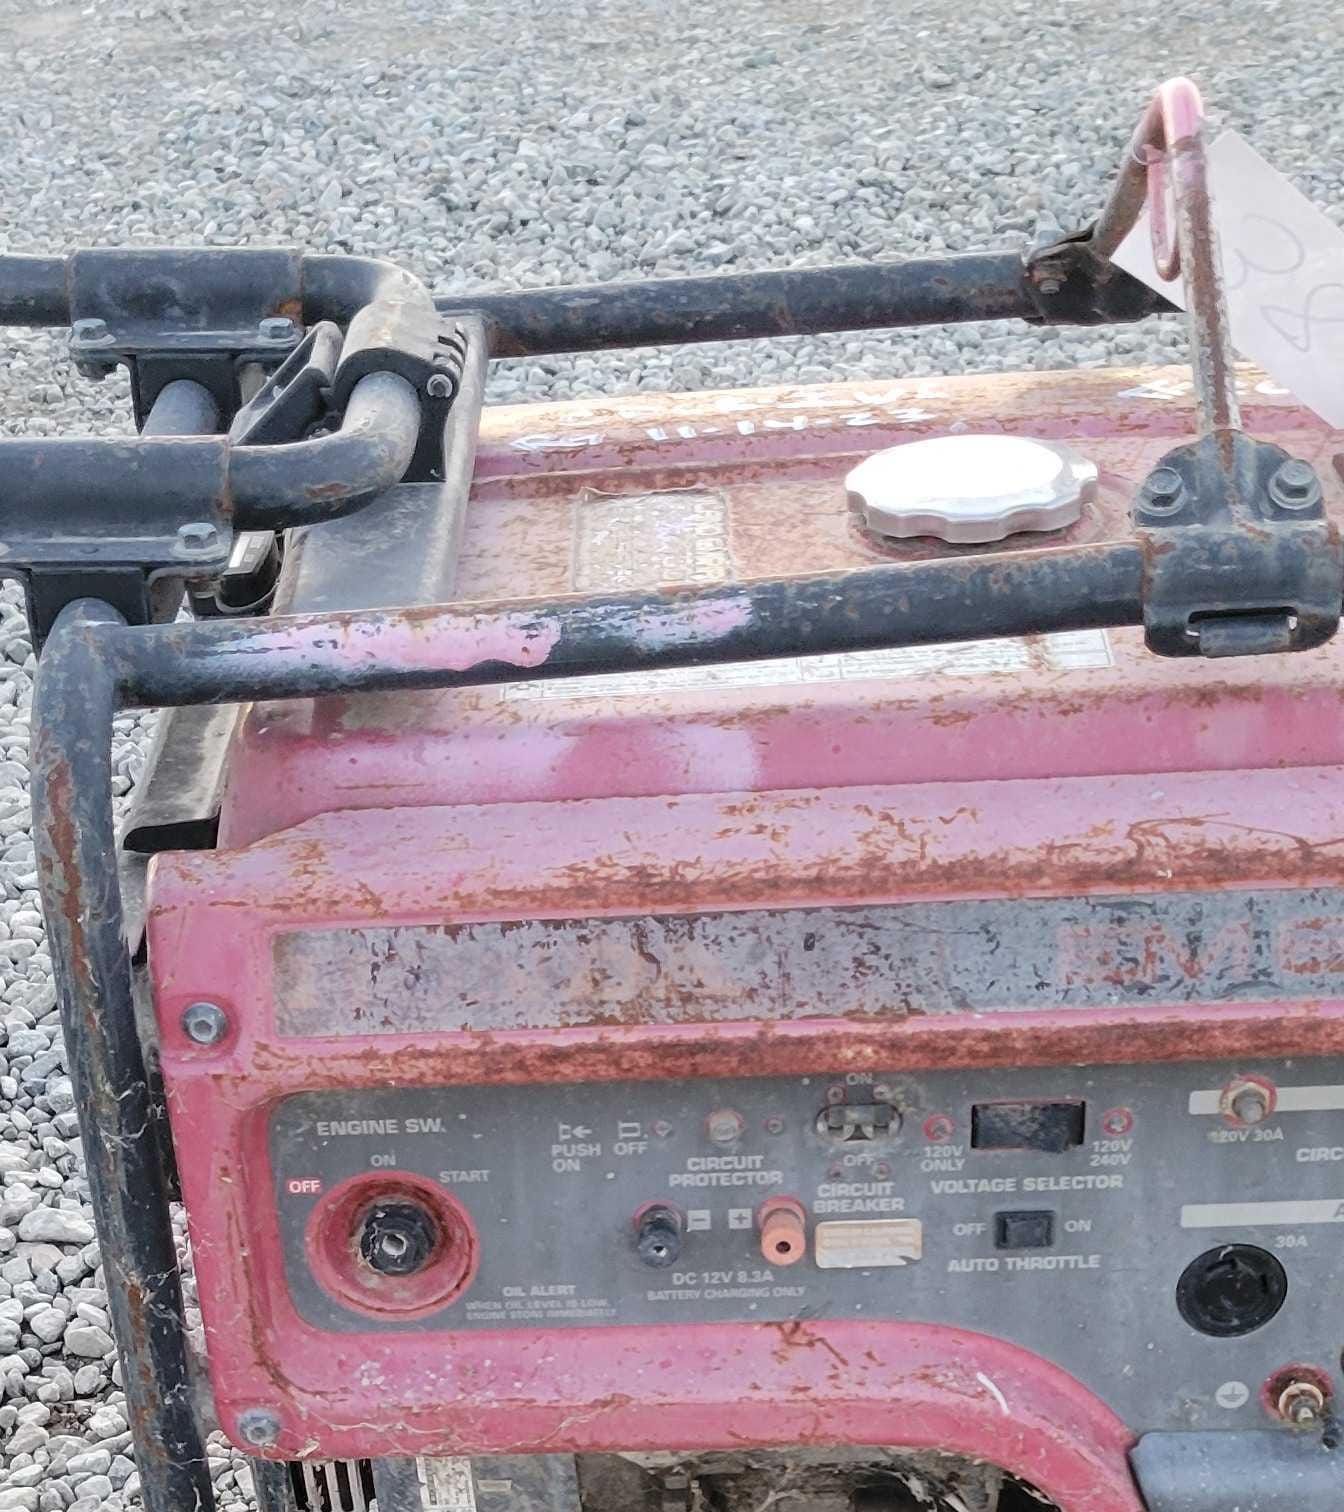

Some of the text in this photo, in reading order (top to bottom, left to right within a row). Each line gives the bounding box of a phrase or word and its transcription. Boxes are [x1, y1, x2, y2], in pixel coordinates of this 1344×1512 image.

[846, 1072, 873, 1085] ON
[316, 1118, 446, 1136] ENGINE SW.
[1253, 1128, 1284, 1142] 30A
[551, 1143, 601, 1157] PUSH
[613, 1141, 648, 1155] OFF
[925, 1145, 964, 1158] 120V
[1092, 1138, 1134, 1152] 120V
[370, 1154, 396, 1167] ON
[552, 1159, 580, 1172] ON
[687, 1156, 764, 1171] CIRCUIT
[843, 1153, 874, 1167] OFF
[920, 1158, 966, 1172] ONLY
[1089, 1153, 1132, 1167] 240V
[440, 1170, 490, 1183] START
[669, 1171, 784, 1187] PROTECTOR
[288, 1180, 321, 1193] OFF
[817, 1182, 894, 1197] CIRCUIT
[931, 1174, 1124, 1194] VOLTAGE SELECTOR
[813, 1198, 904, 1213] BREAKER
[952, 1222, 987, 1236] OFF
[1064, 1219, 1092, 1232] ON
[1275, 1235, 1307, 1248] 30A
[947, 1254, 1102, 1272] AUTO THROTTLE
[672, 1272, 697, 1285] DC
[702, 1271, 733, 1284] 12V
[502, 1285, 576, 1297] OIL ALERT
[647, 1289, 701, 1301] BATTERY
